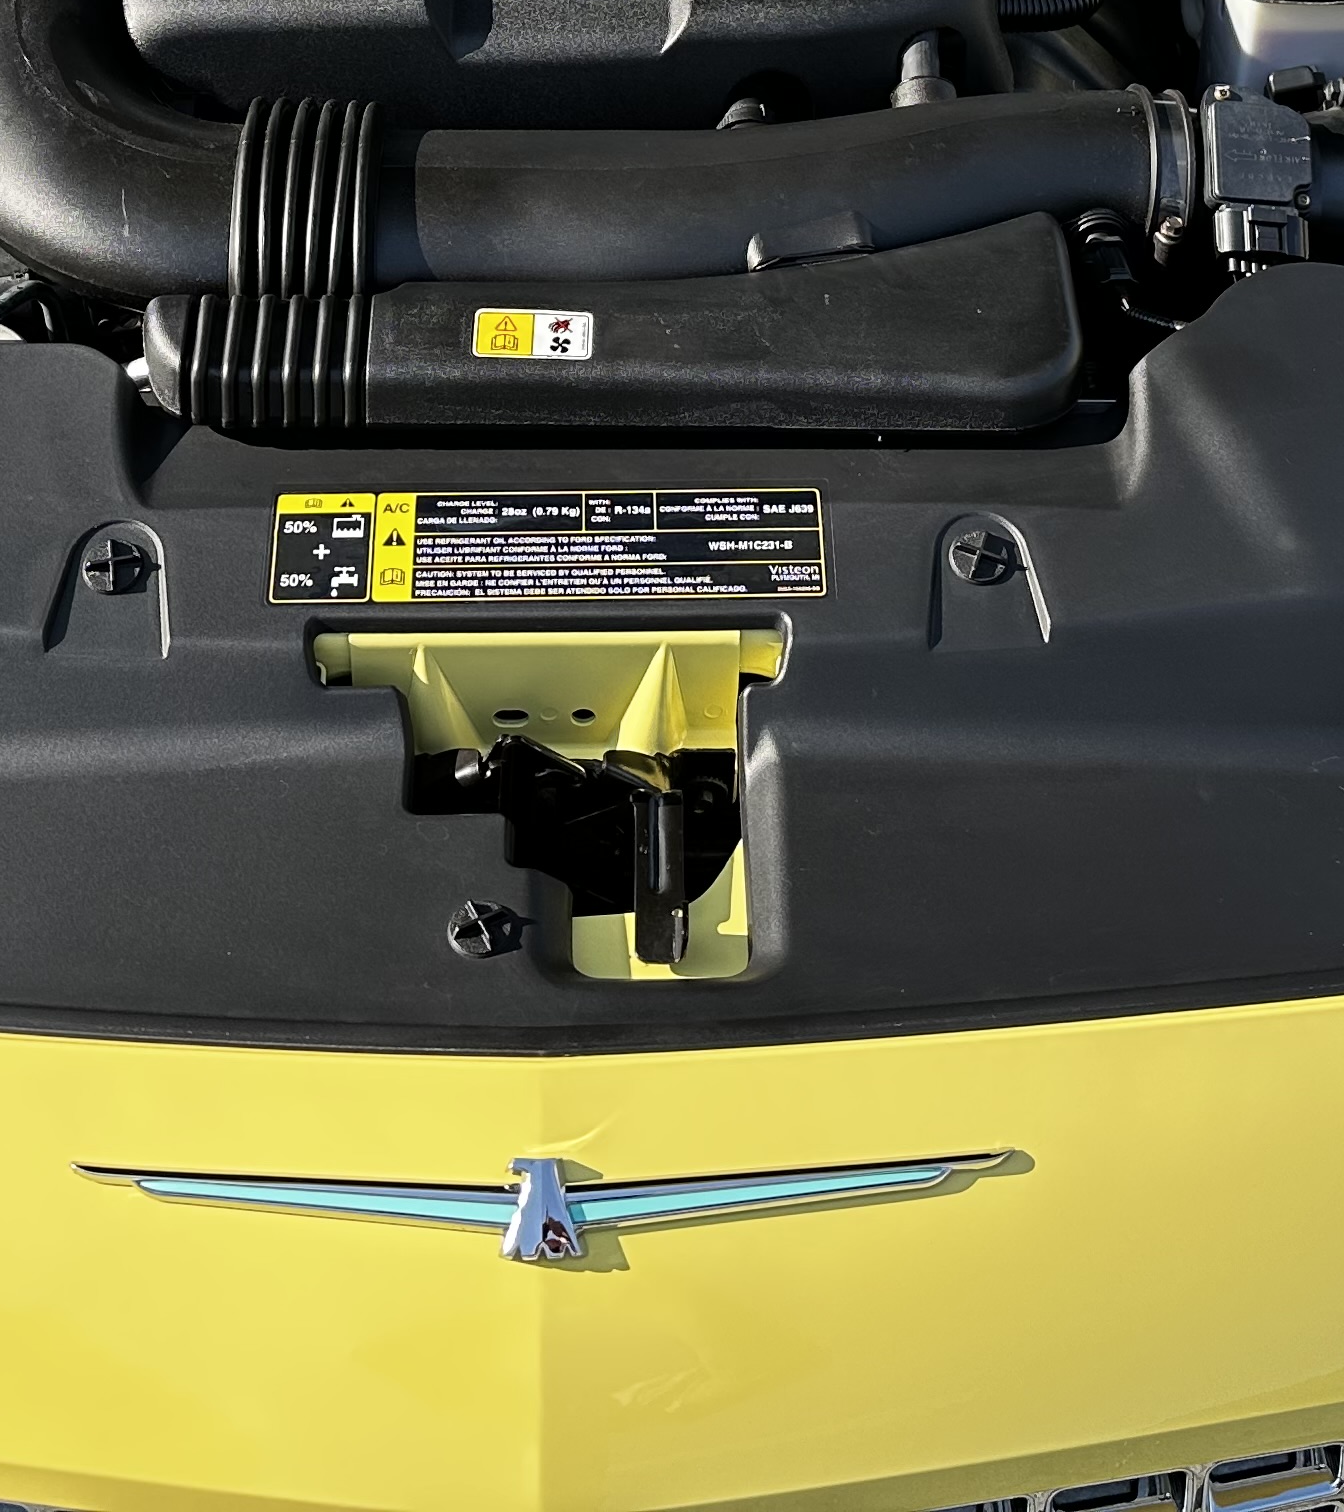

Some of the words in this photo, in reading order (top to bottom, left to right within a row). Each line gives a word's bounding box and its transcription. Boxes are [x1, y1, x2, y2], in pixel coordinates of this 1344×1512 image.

[383, 503, 410, 513] A/C
[502, 507, 527, 517] 28oz
[532, 506, 558, 517] (0.79
[561, 506, 580, 516] Kg)
[614, 506, 651, 515] R-134a
[762, 504, 786, 514] SAE
[788, 504, 814, 514] J639
[283, 521, 317, 533] 50%
[768, 565, 819, 574] Visteon
[280, 574, 313, 587] 50%
